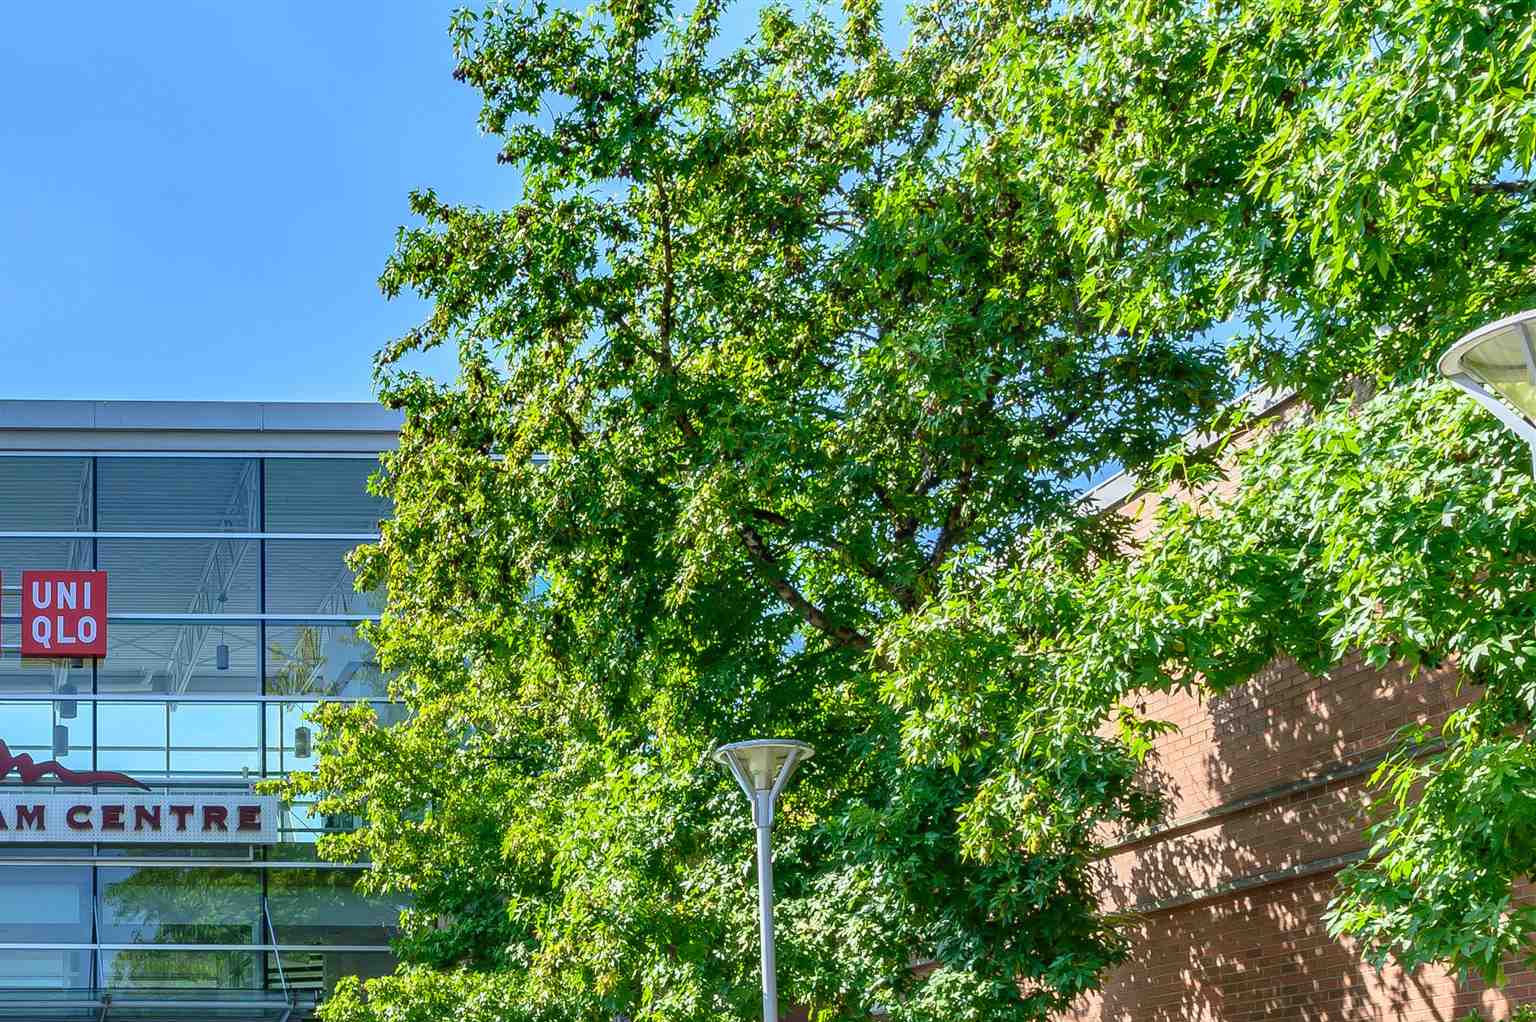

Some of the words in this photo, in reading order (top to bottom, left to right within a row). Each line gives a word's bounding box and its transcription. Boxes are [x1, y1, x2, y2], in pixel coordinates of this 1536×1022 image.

[31, 581, 92, 610] UNI
[31, 615, 98, 649] QLO
[65, 804, 263, 832] CENTRE
